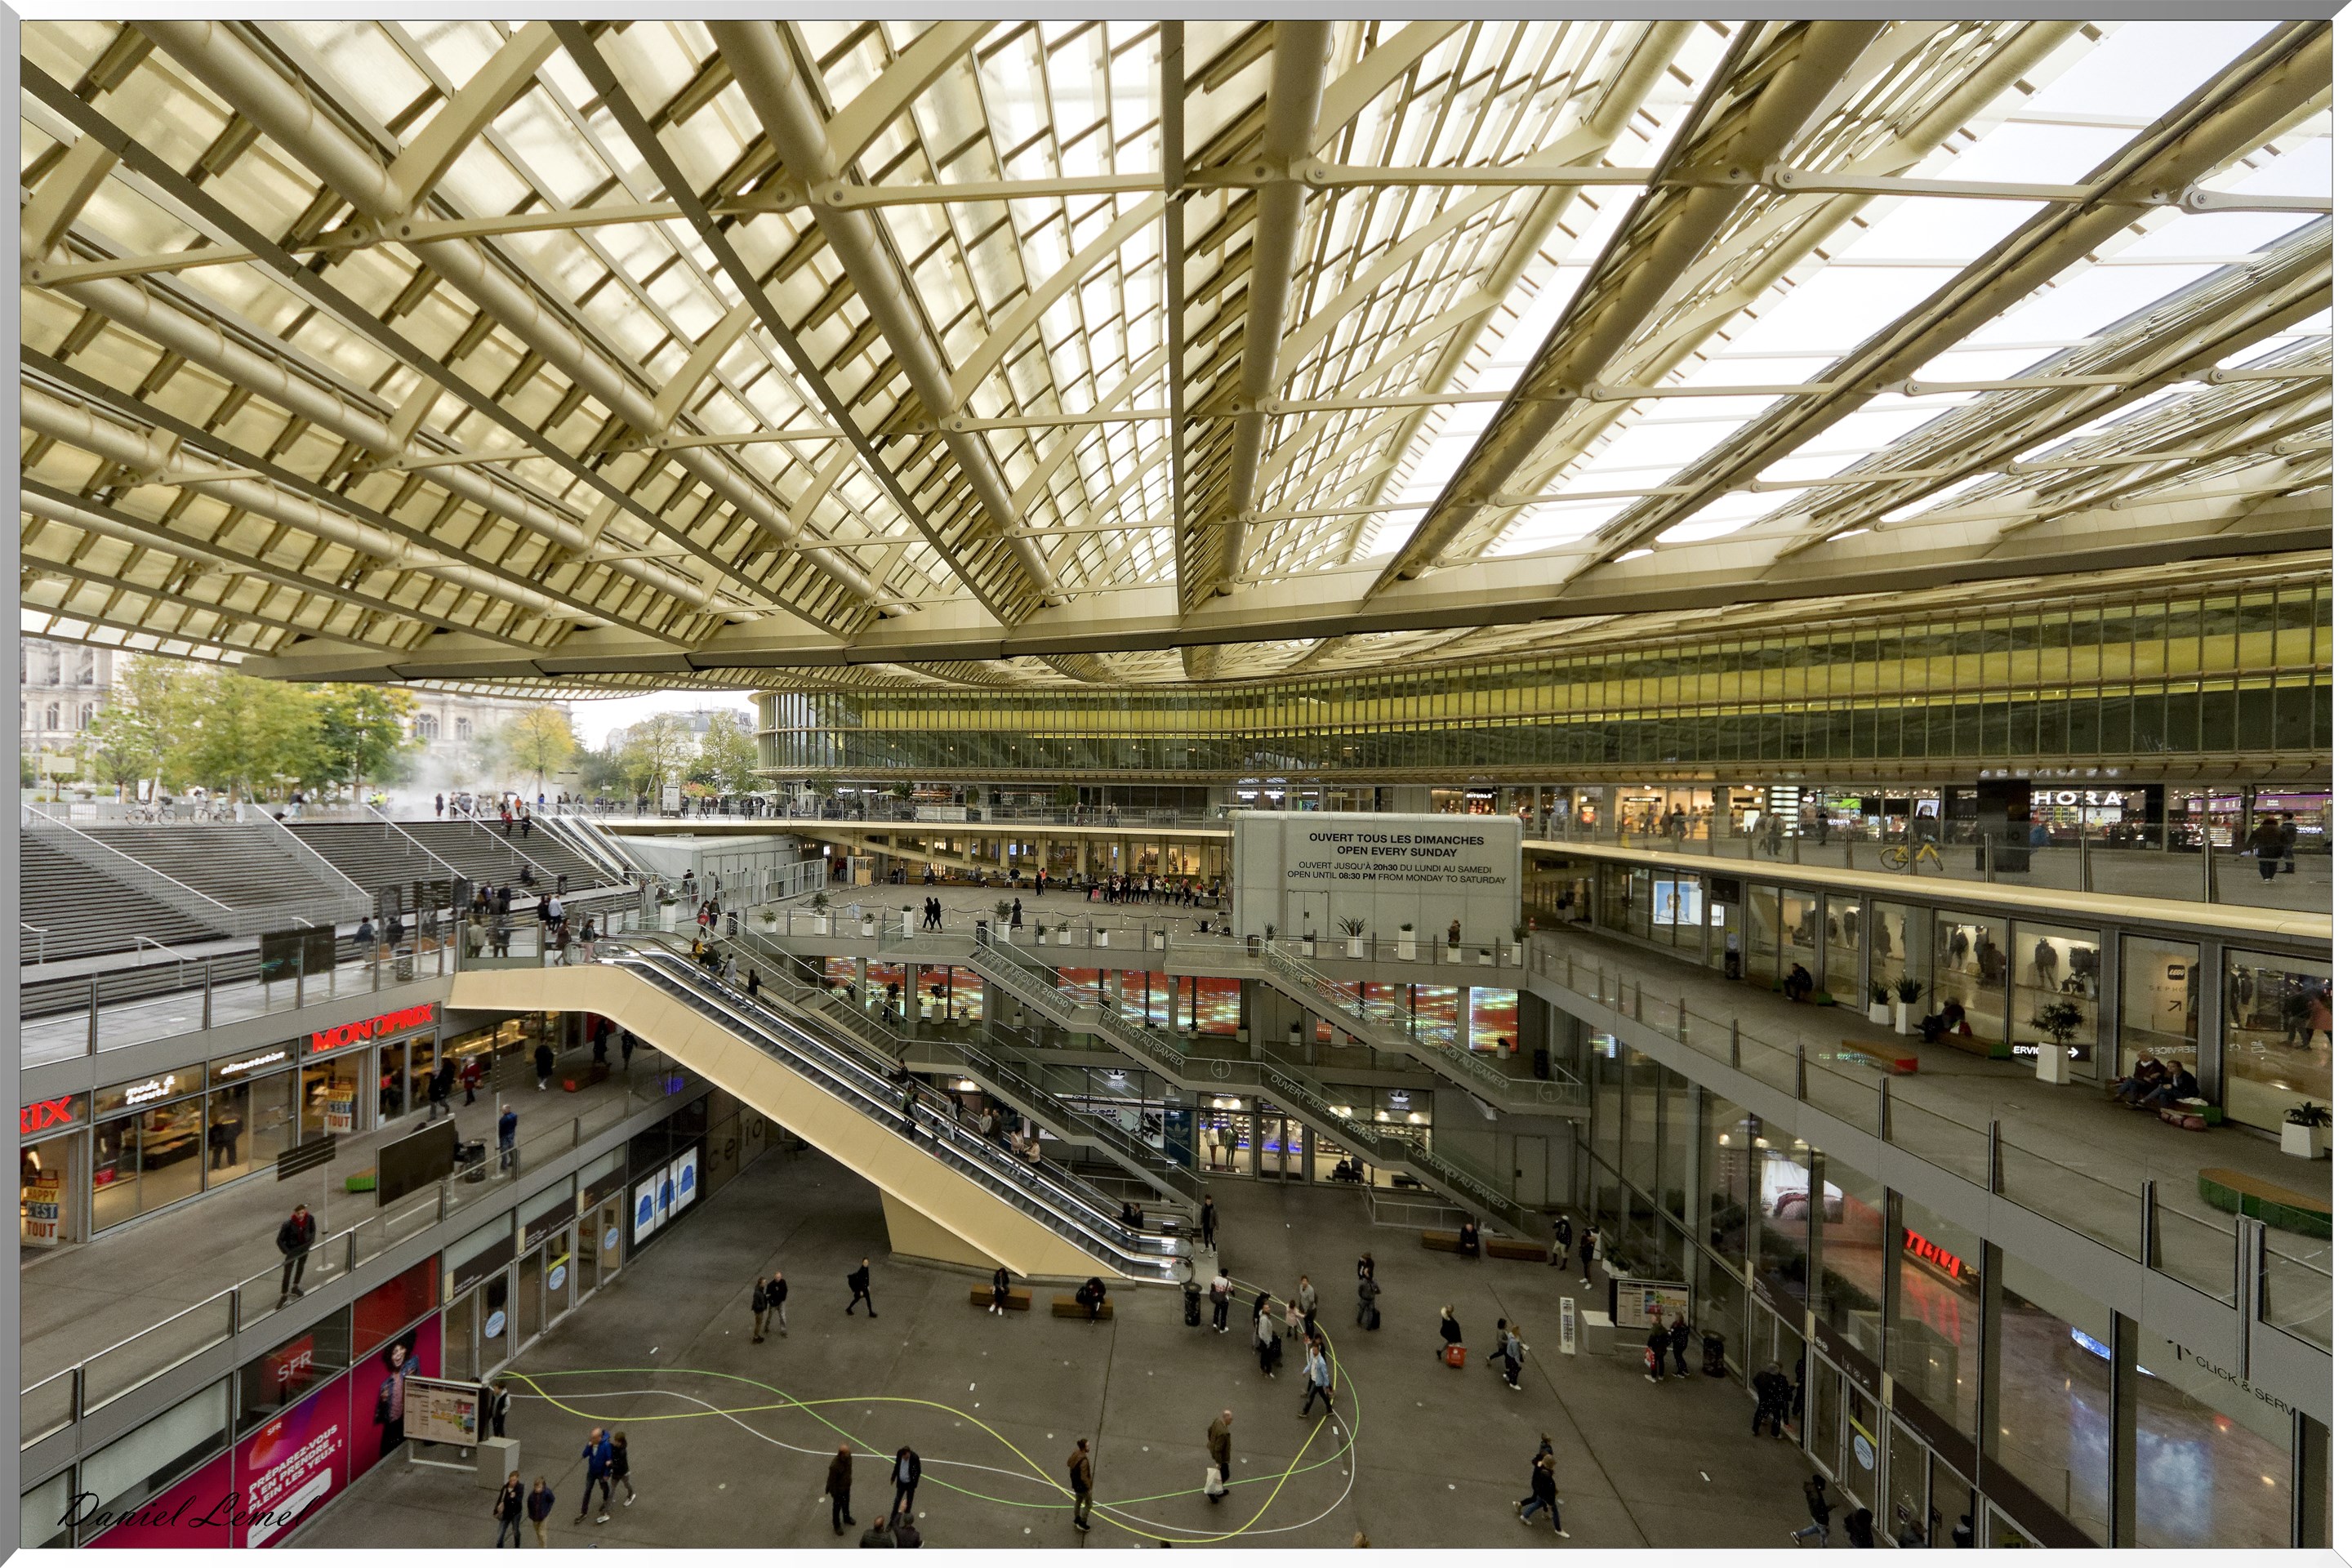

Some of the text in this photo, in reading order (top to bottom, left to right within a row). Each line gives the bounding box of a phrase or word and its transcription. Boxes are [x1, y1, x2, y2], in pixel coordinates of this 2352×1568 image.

[2034, 791, 2123, 805] HORA
[1309, 833, 1485, 845] OUVERT TOUS LES DIMANCHES
[1337, 846, 1458, 858] OPEN EVERY SUNDAY
[1334, 862, 1371, 871] JUSQU'À
[1458, 866, 1492, 874] SAMEDI
[1460, 876, 1507, 884] SATURDAY
[974, 945, 1006, 968] OUVERT
[1041, 987, 1069, 1008] 20H30
[1271, 957, 1303, 981] OUVER
[2149, 985, 2185, 993] SEPHO
[312, 1004, 434, 1053] MONOPRIX
[1102, 1012, 1186, 1067] DU LUNDI AU SAMEDI
[2013, 1045, 2039, 1055] ERVIC
[327, 1115, 350, 1127] TOUT
[1271, 1074, 1307, 1100] OUVERT
[1346, 1120, 1378, 1144] 20H30
[1415, 1148, 1508, 1209] DU LUNDI AU SAMEDI
[27, 1221, 56, 1237] TOUT
[278, 1350, 311, 1382] SFR
[2196, 1356, 2297, 1416] CLICK & SERV
[267, 1422, 283, 1437] SFR
[249, 1424, 338, 1494] PRÉPAREZ-VOUS
[261, 1478, 277, 1495] EN
[279, 1439, 330, 1481] PRENDRE
[248, 1483, 283, 1515] PLEIN
[285, 1467, 305, 1487] LES
[307, 1444, 336, 1470] YEUX
